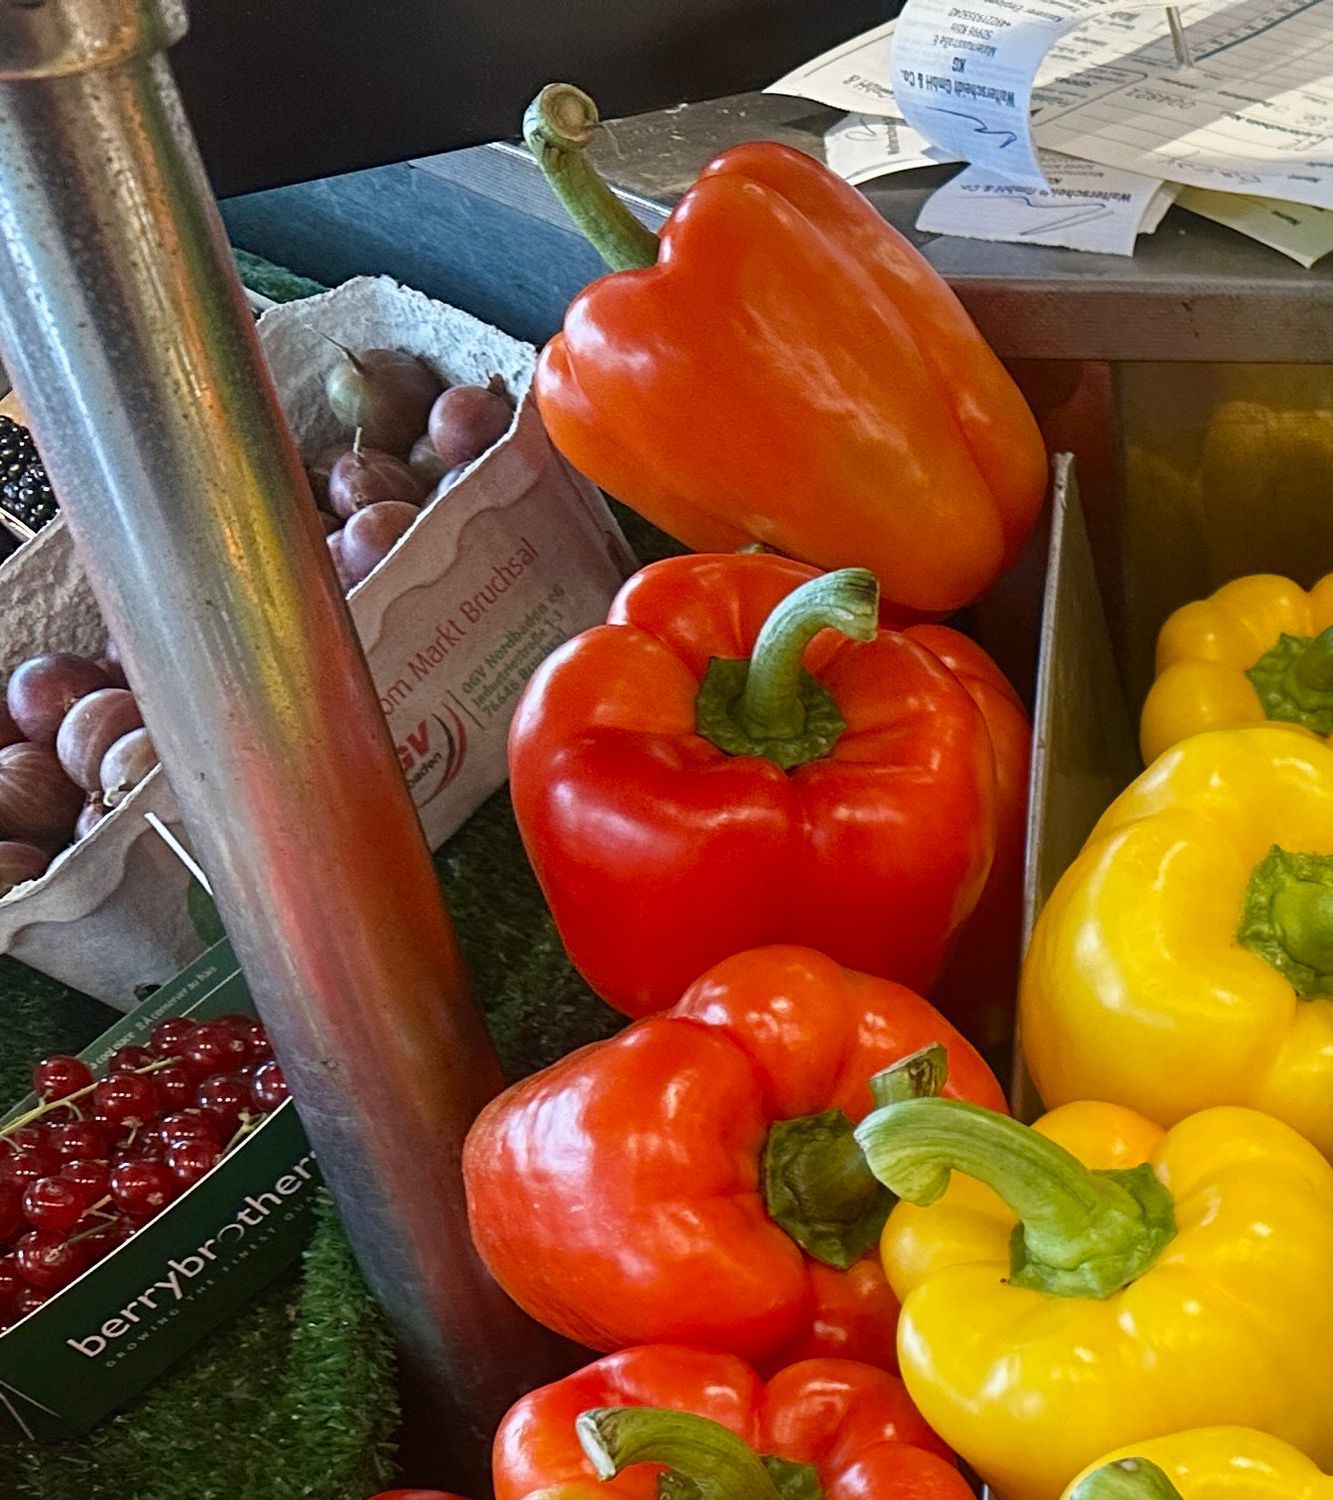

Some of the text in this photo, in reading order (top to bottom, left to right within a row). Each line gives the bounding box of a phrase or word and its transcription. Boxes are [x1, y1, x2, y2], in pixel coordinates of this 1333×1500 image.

[952, 57, 966, 72] KG
[900, 69, 915, 86] Co.
[918, 72, 924, 89] &
[926, 75, 952, 94] GmbH
[954, 80, 1015, 107] Walterscheidt
[380, 537, 539, 716] om Markt Bruchsal
[66, 1150, 317, 1358] berrybrother
[105, 1307, 180, 1368] GROWING
[187, 1278, 215, 1301] THE
[223, 1226, 277, 1273] FINEST
